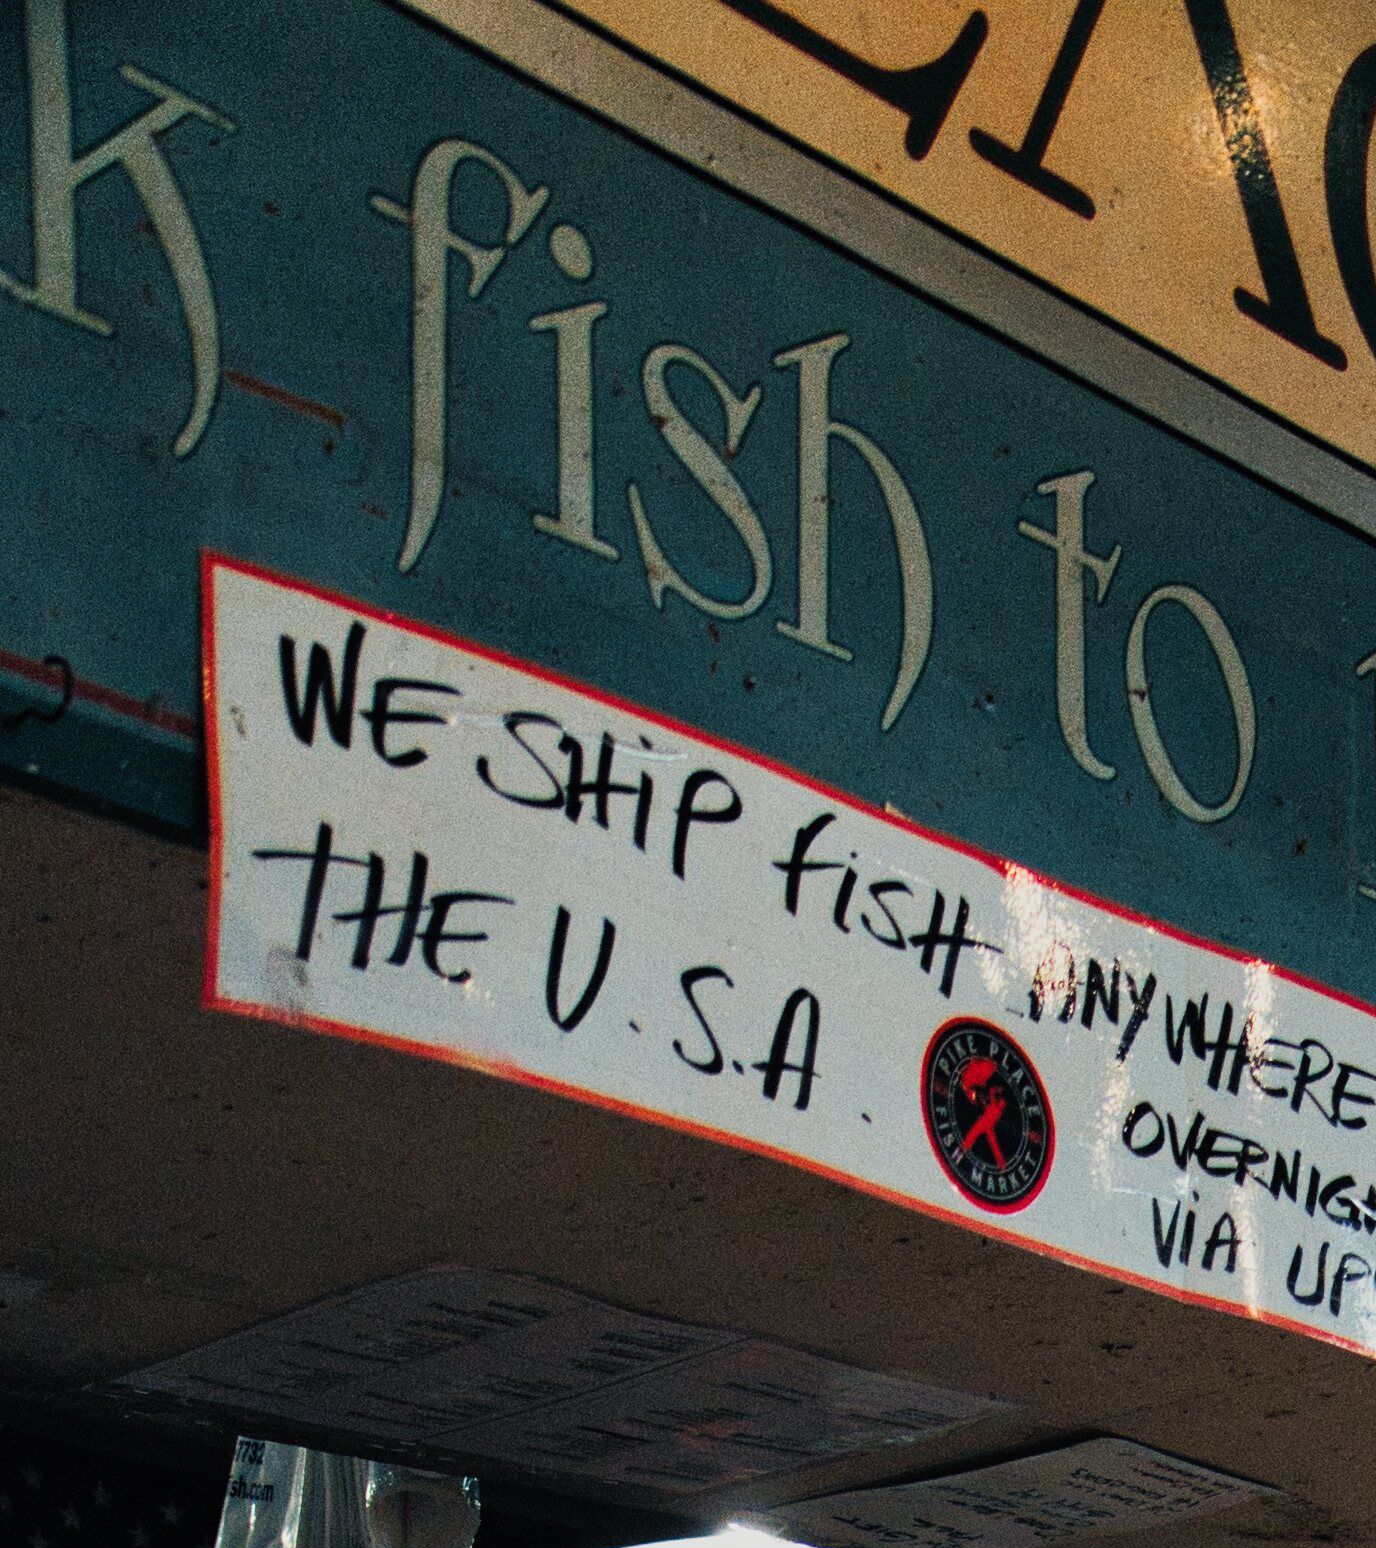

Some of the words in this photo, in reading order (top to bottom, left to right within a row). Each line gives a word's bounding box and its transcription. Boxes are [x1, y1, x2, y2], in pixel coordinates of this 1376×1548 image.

[370, 138, 935, 734] fish
[1017, 469, 1259, 824] to
[279, 620, 464, 769] WE
[252, 820, 516, 984] THE
